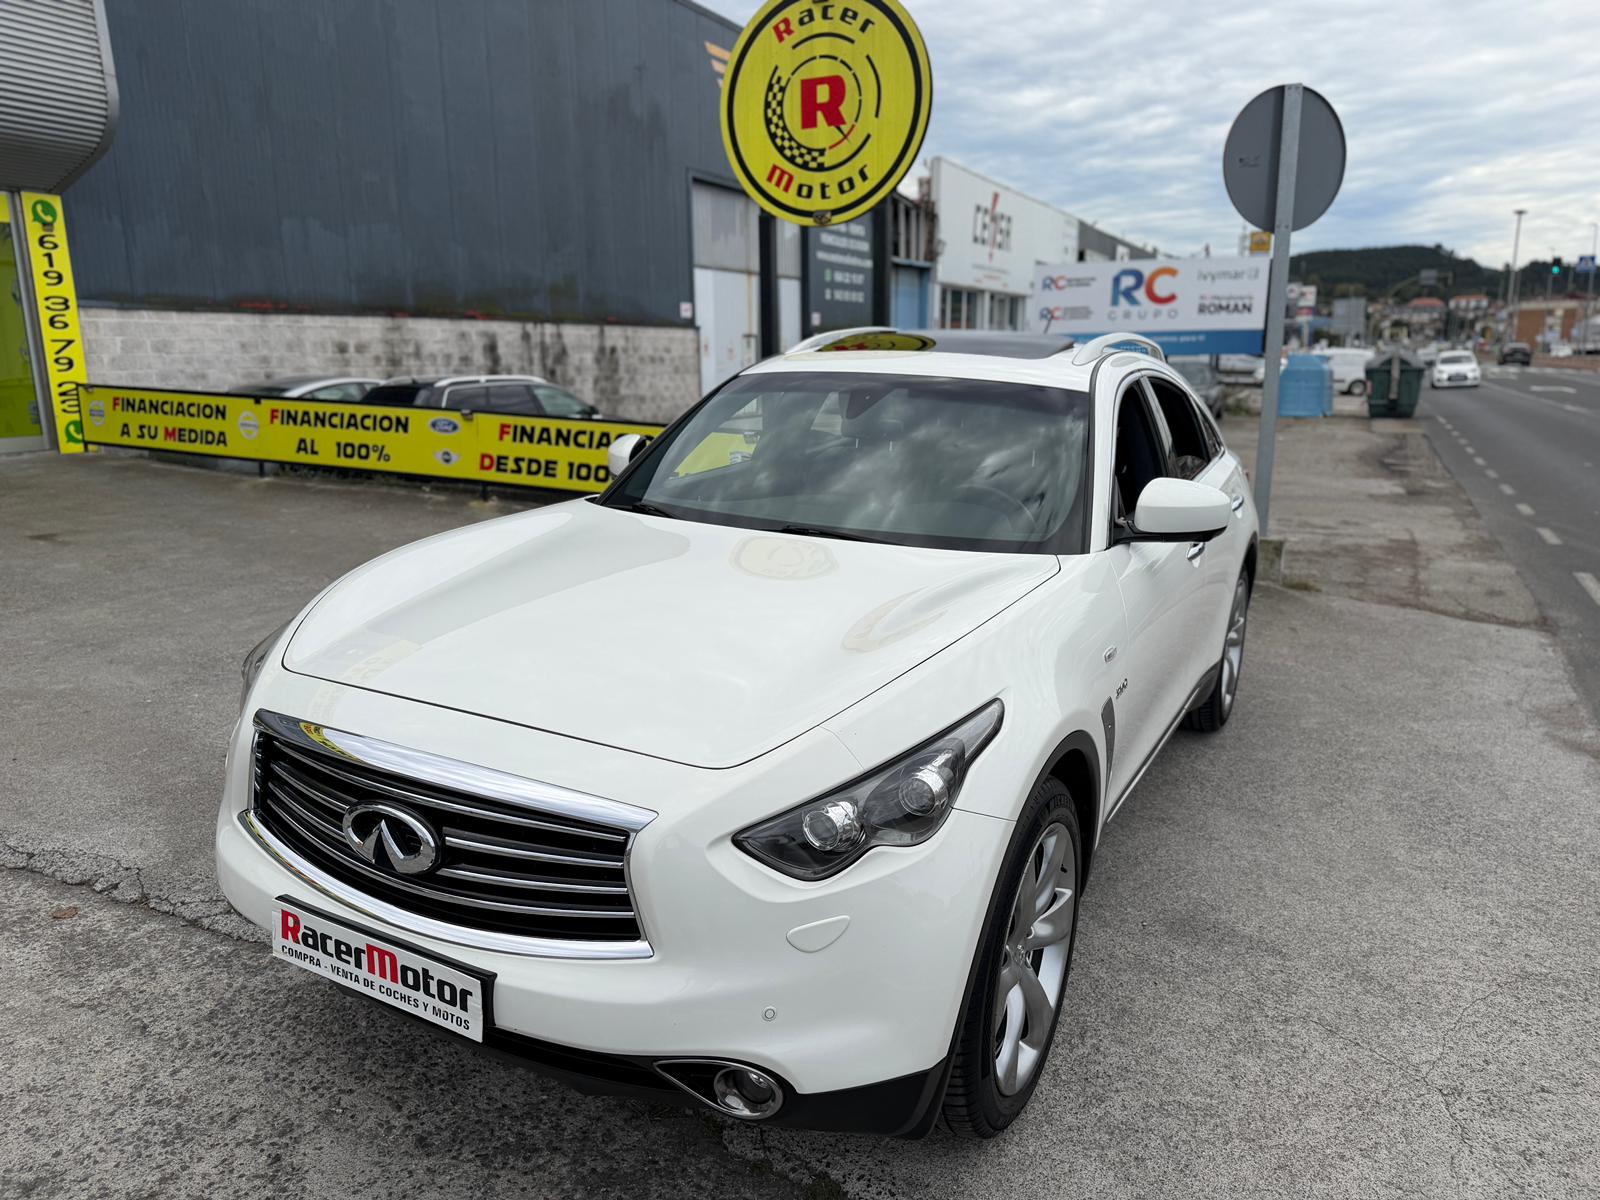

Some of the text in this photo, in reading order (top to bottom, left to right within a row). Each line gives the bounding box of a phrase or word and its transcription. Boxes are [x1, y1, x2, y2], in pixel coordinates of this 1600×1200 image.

[772, 5, 875, 43] Racer
[800, 75, 847, 129] R
[766, 164, 869, 199] Motor
[38, 234, 63, 286] 619
[1110, 266, 1179, 306] RC
[44, 295, 70, 329] 36
[1107, 308, 1178, 321] GRUPO
[50, 339, 75, 372] 79
[113, 397, 227, 420] FINANCIACION
[270, 408, 409, 433] FINANCIACION
[120, 423, 227, 447] A SU MEDIDA
[296, 438, 390, 462] AL 100%
[499, 423, 654, 449] FINANCIA
[480, 453, 617, 483] DESDE 100
[281, 909, 473, 1013] RacerMotor
[281, 944, 321, 969] COMPRA
[330, 963, 360, 985] VENTA
[363, 976, 376, 991] DE
[379, 982, 419, 1009] COCHES
[422, 1000, 430, 1013] Y
[432, 1006, 470, 1031] MOTOS
